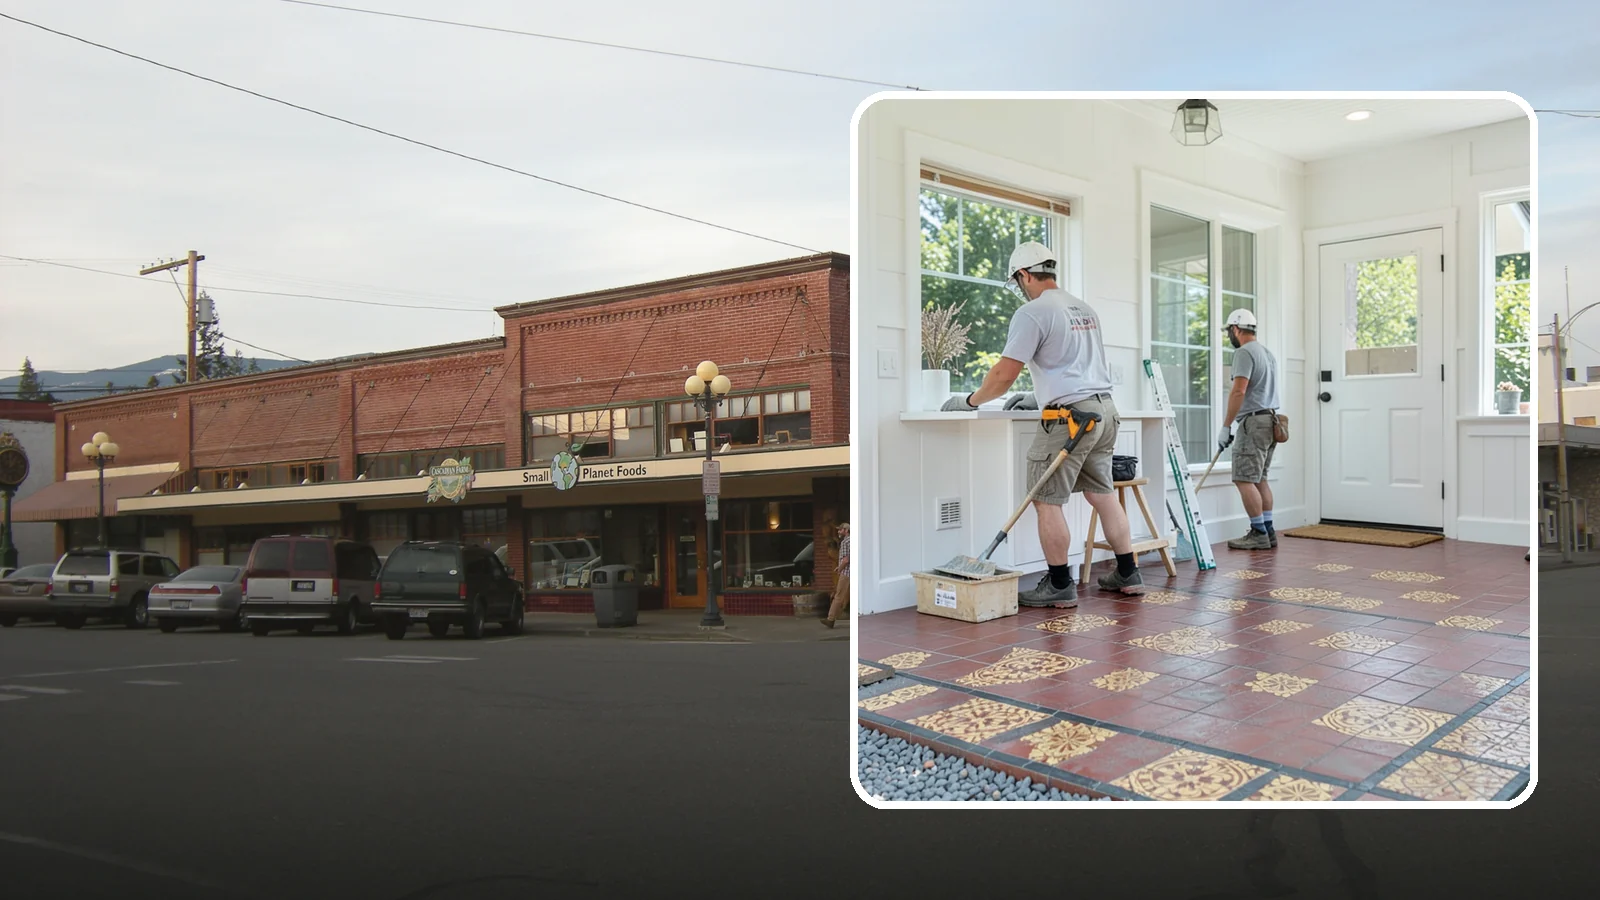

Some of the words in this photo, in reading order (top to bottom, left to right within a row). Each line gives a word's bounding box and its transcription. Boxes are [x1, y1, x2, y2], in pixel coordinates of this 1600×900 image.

[523, 471, 549, 483] Small
[582, 467, 614, 479] Planet
[617, 464, 647, 477] Foods
